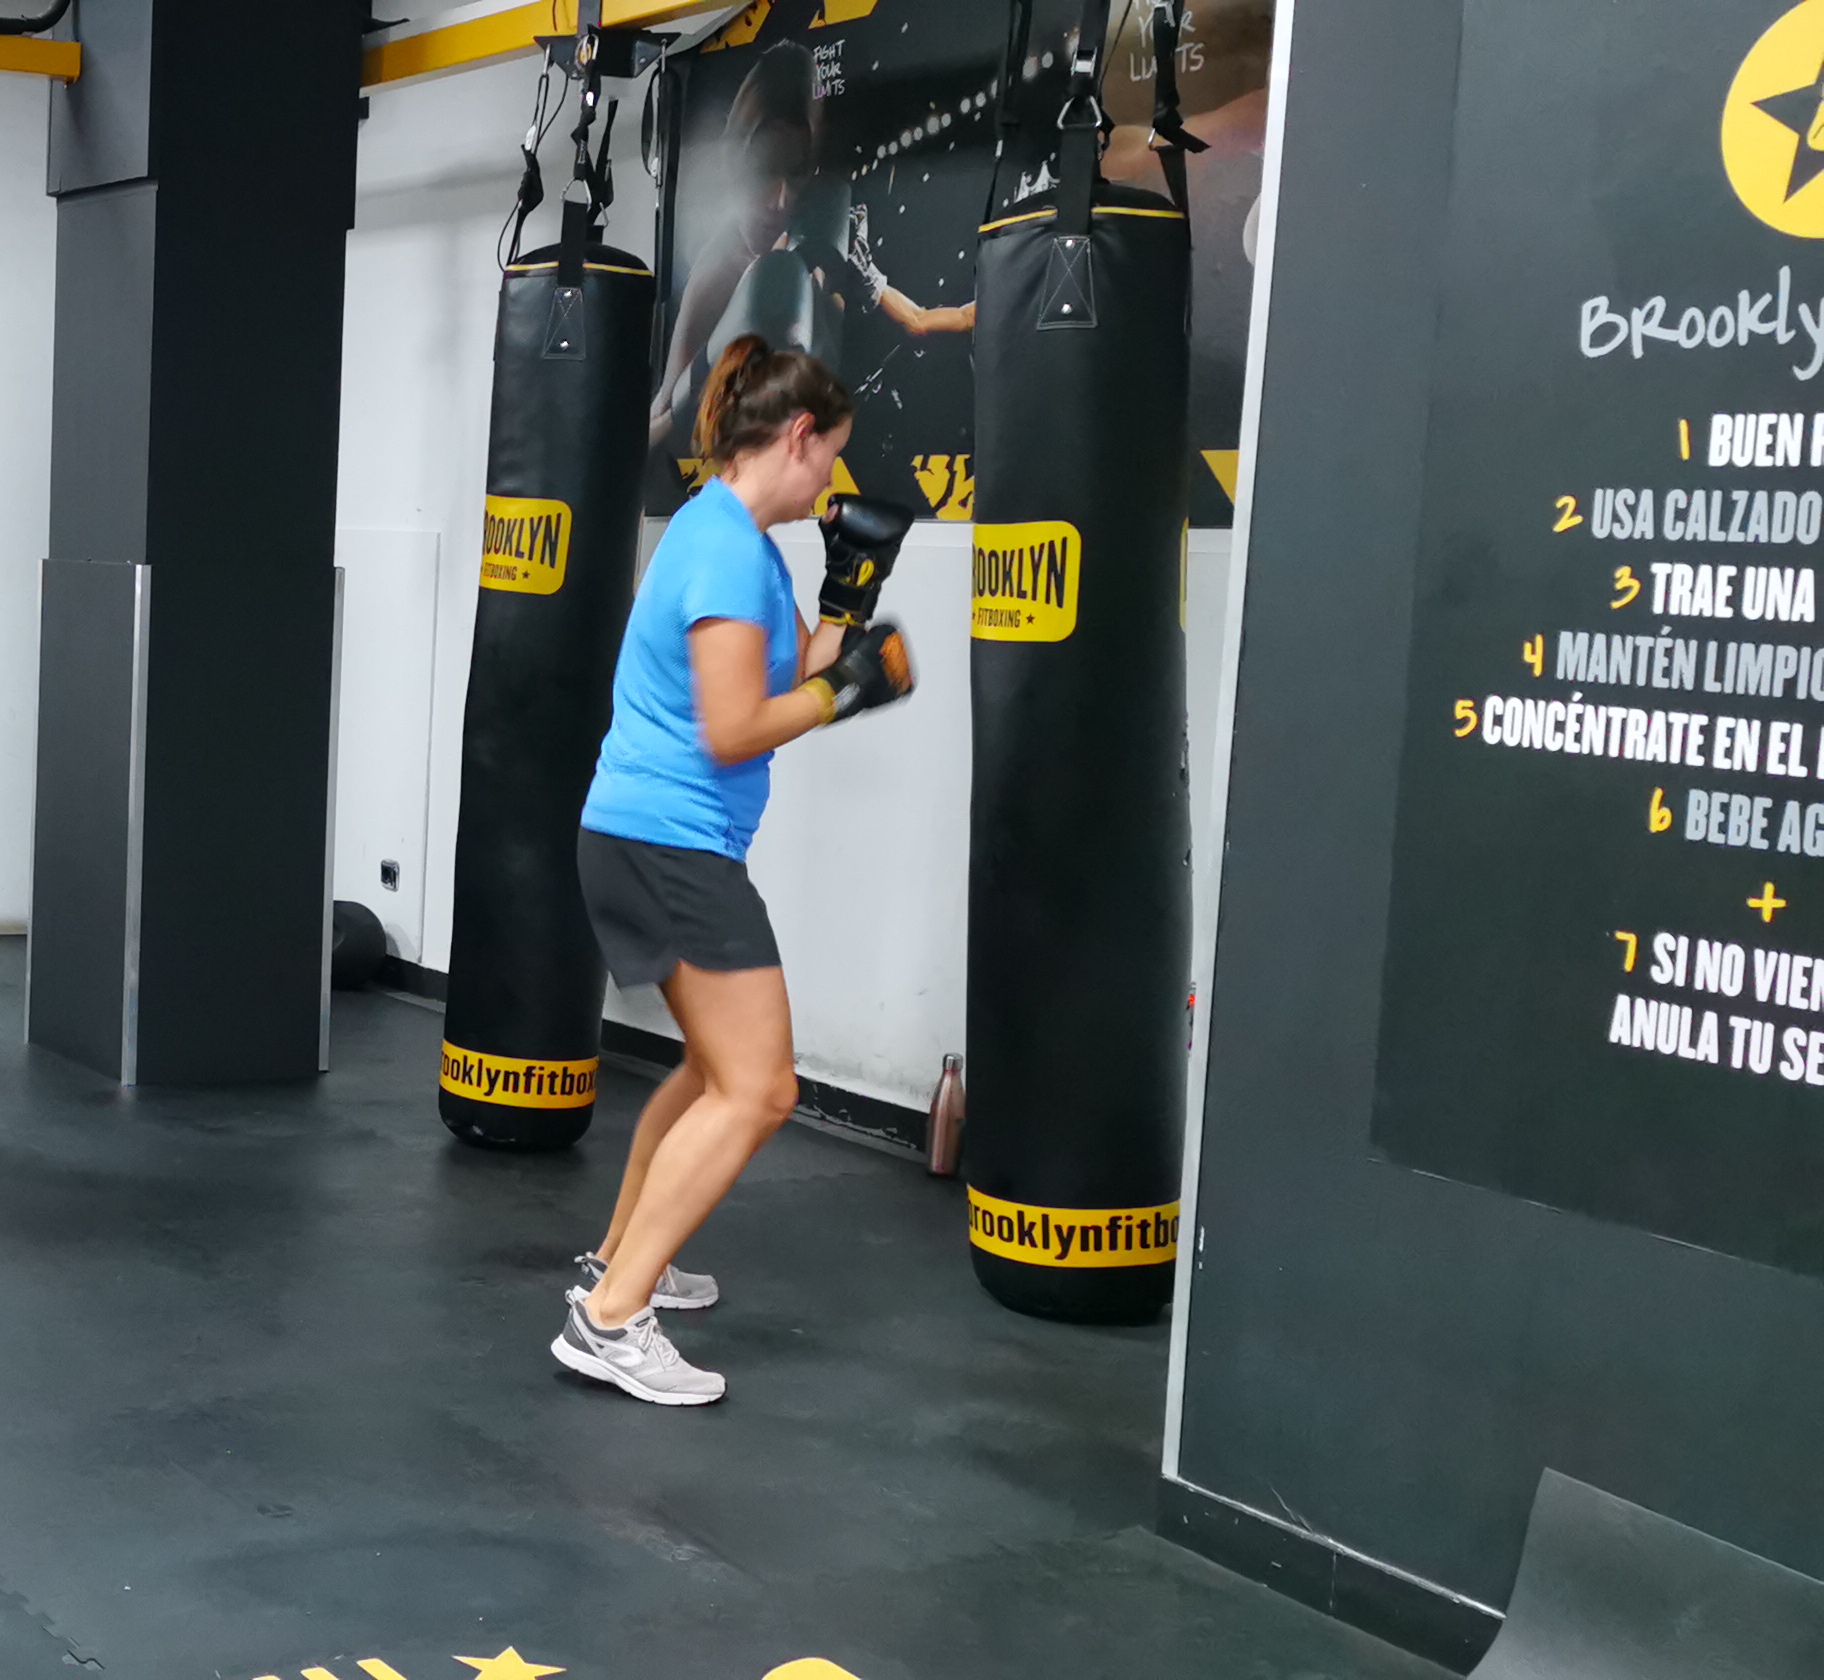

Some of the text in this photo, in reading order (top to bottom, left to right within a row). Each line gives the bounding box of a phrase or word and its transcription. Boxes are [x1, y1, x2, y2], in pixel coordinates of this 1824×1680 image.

[816, 62, 842, 81] YOUR
[1678, 418, 1690, 460] 1
[1707, 413, 1804, 467] BUEN
[1552, 487, 1823, 545] 2 USA CALZADO
[977, 607, 1021, 629] FITBOXING
[1611, 562, 1816, 623] 3 TRAE UNA
[1523, 633, 1544, 677] 4
[1556, 625, 1698, 691] MANTÉN
[1453, 699, 1477, 737] 5
[1481, 692, 1709, 767] CONCÉNTRATE
[1712, 715, 1761, 773] EN
[1766, 720, 1809, 778] EL
[1649, 787, 1824, 857] 6 BEBE AG
[1614, 930, 1638, 973] 7
[1649, 932, 1690, 988] SI
[1693, 938, 1746, 997] NO
[1609, 993, 1824, 1087] ANULA TU SE
